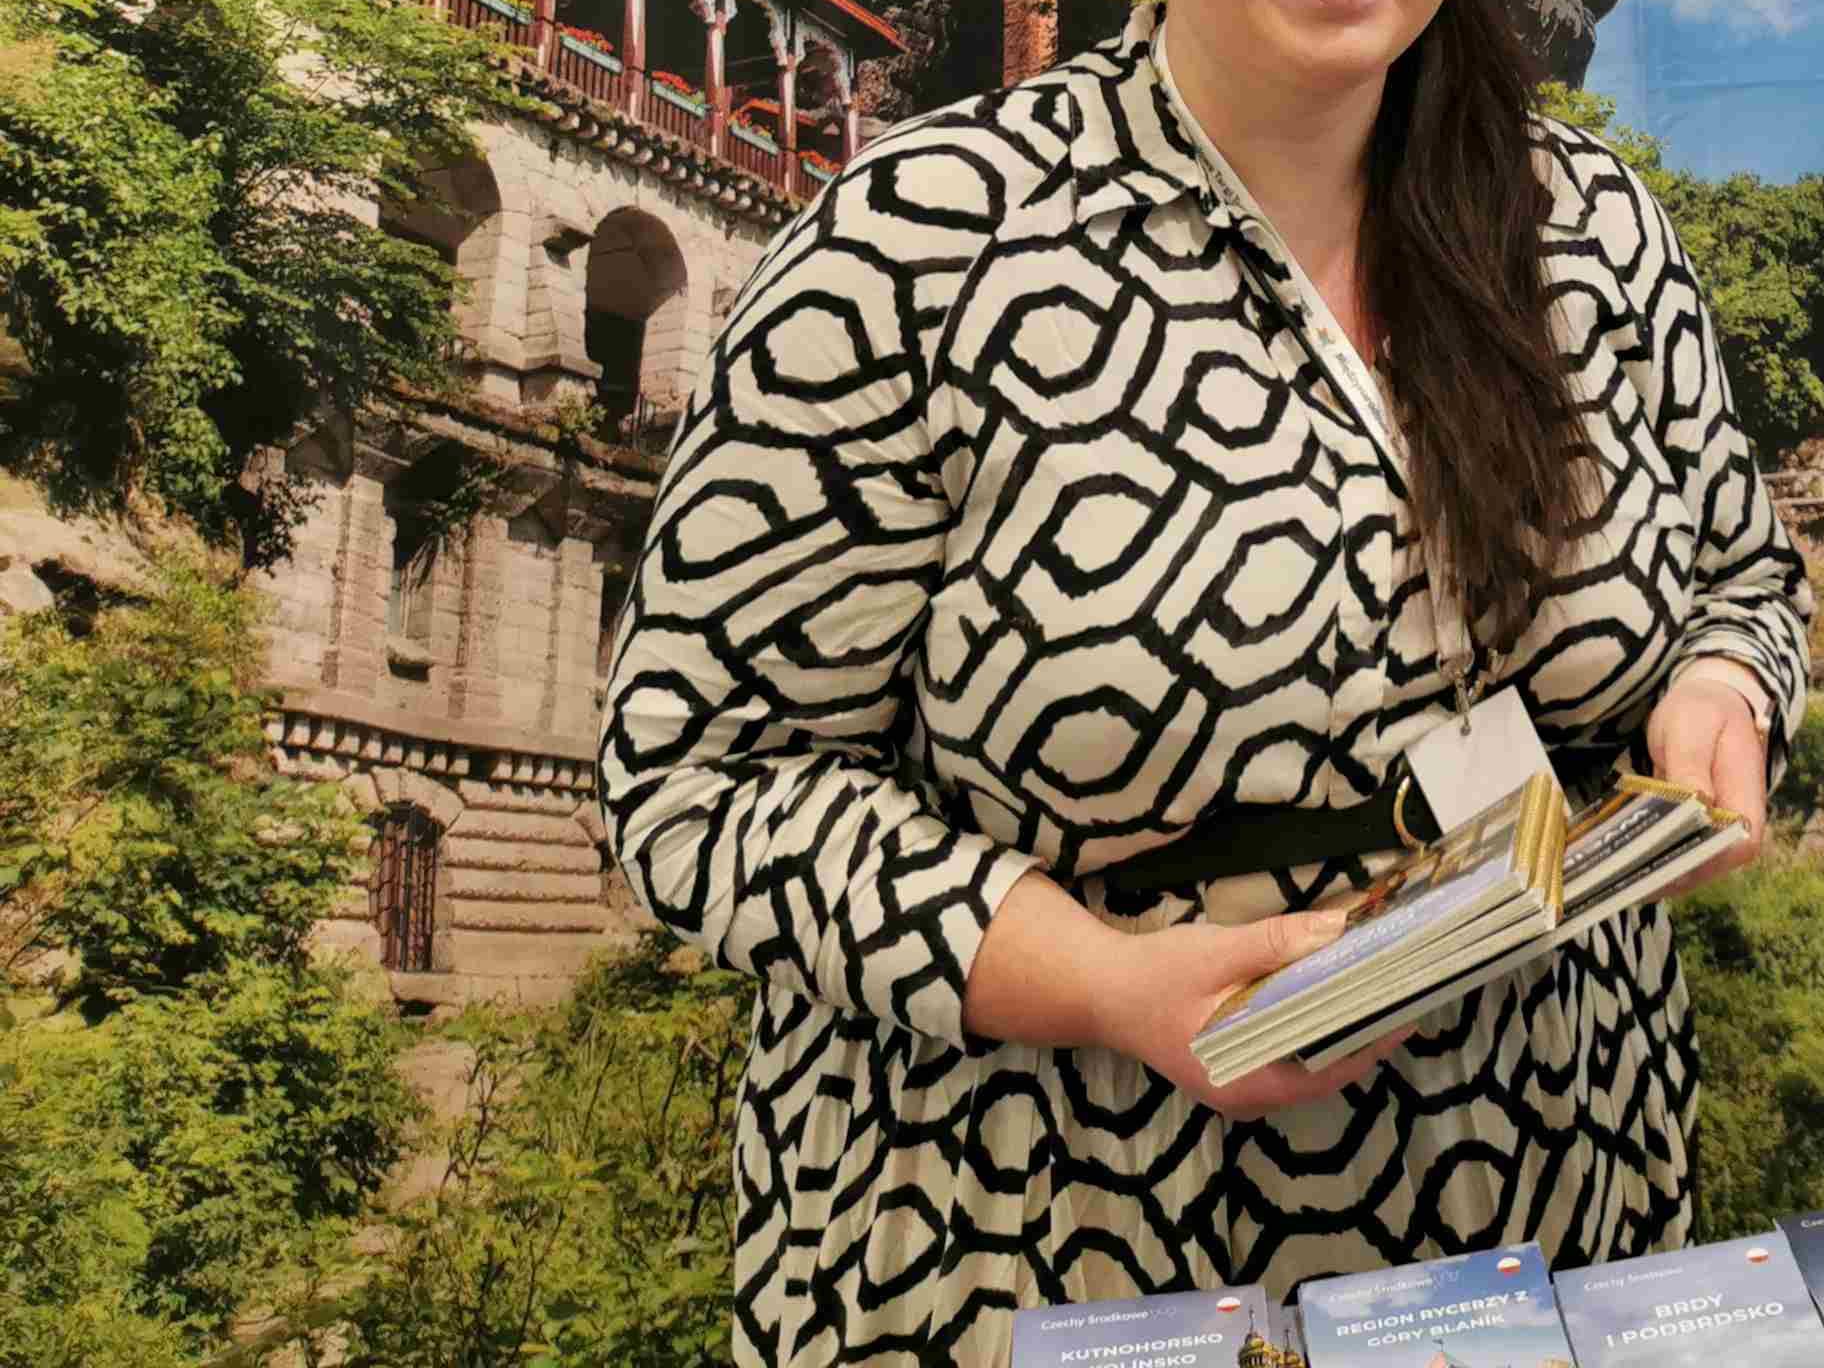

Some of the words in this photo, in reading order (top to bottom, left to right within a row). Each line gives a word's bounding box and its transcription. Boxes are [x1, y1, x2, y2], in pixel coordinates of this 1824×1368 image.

[1040, 1315, 1086, 1331] Czechy
[1087, 1309, 1150, 1326] Środkowe
[1336, 1313, 1414, 1337] REGION
[1419, 1293, 1510, 1322] RYCERZY
[1513, 1289, 1530, 1303] Z
[1654, 1292, 1724, 1319] BRDY
[1367, 1329, 1425, 1348] GÓRY
[1429, 1313, 1506, 1338] BLANÍK
[1605, 1333, 1615, 1349] I
[1621, 1301, 1785, 1345] PODBRDSKO
[1060, 1332, 1225, 1364] KUTNOHORSKO
[1088, 1352, 1197, 1368] OLÍNSKO
